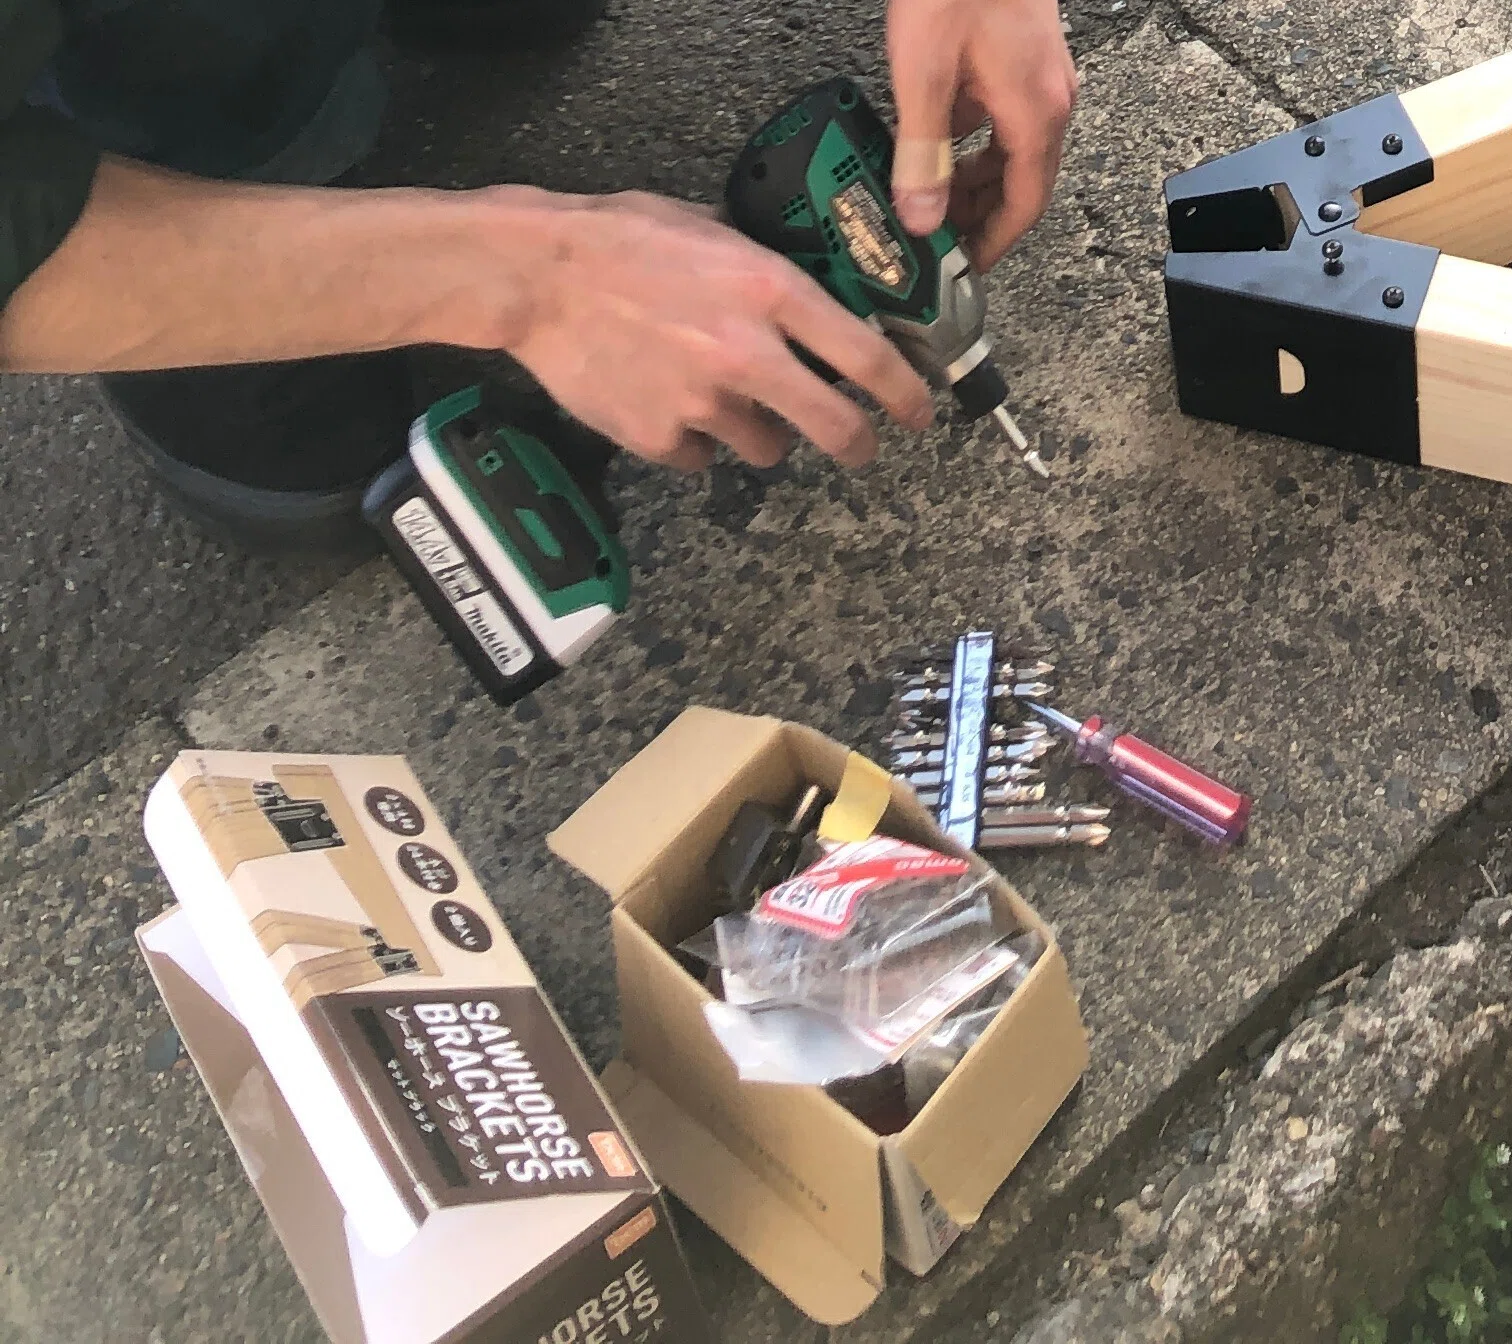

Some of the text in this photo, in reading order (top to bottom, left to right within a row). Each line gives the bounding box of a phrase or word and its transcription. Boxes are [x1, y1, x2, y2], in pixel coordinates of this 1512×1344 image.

[413, 1003, 550, 1182] BRACKETS
[460, 1001, 594, 1179] SAWHORSE
[537, 1259, 650, 1344] ORSE
